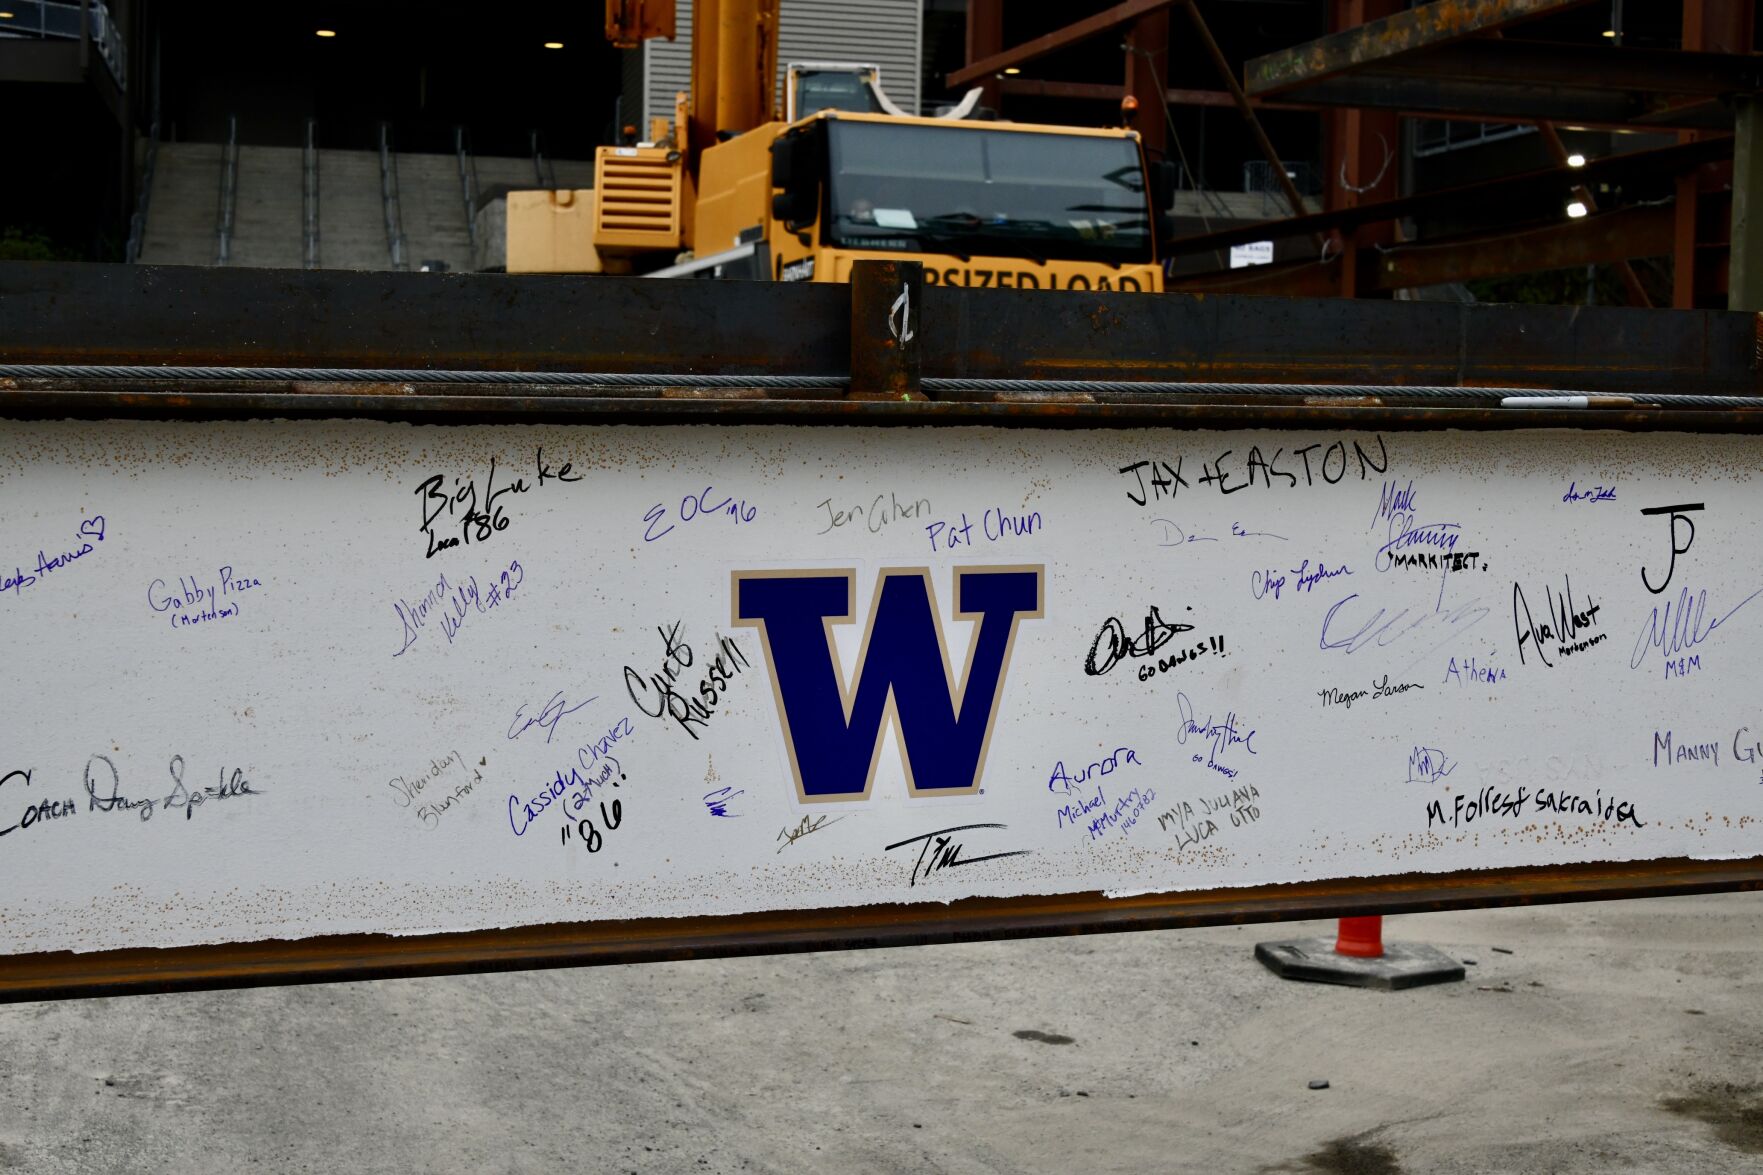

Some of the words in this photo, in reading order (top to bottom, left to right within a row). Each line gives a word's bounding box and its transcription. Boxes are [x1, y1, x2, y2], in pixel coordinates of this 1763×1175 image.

[415, 474, 477, 533] Big
[1119, 457, 1189, 507] JAX
[817, 498, 863, 535] Jen
[925, 512, 974, 552] Pat
[983, 507, 1043, 541] Chun
[147, 575, 216, 613] Gabby
[219, 565, 262, 596] Pizza
[731, 563, 1045, 805] W
[1138, 664, 1156, 682] GO
[1317, 687, 1369, 709] Megan
[1372, 674, 1425, 700] Larson
[1048, 747, 1142, 792] Aurora
[1653, 730, 1719, 768] MANNY
[508, 767, 586, 836] Cassidy
[578, 717, 634, 770] Chavez
[1057, 785, 1106, 829] Michael
